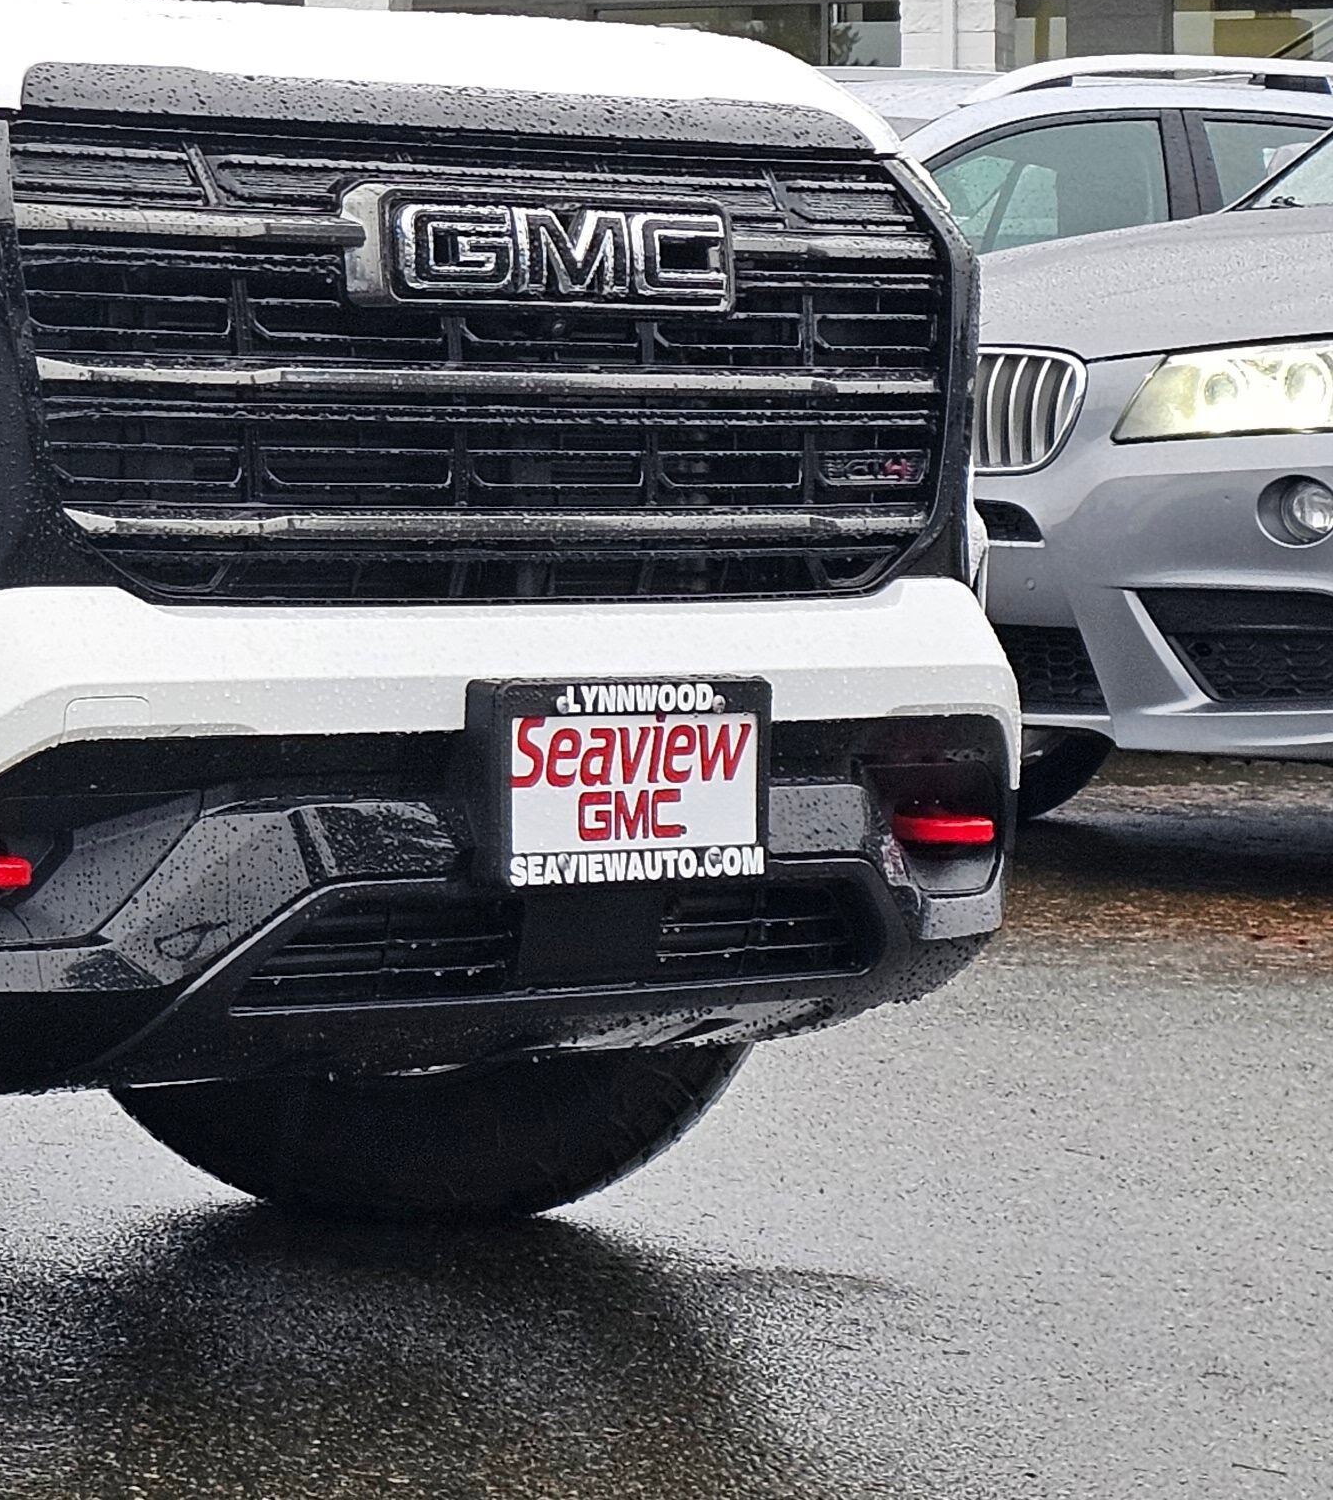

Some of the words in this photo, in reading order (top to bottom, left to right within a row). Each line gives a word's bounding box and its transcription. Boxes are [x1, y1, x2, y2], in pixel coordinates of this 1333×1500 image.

[398, 203, 728, 297] GMC
[566, 683, 714, 713] LYNNWOOD
[510, 713, 752, 789] Seaview
[578, 789, 682, 841] GMC
[509, 847, 765, 887] SEAVIEWAUTO.COM
